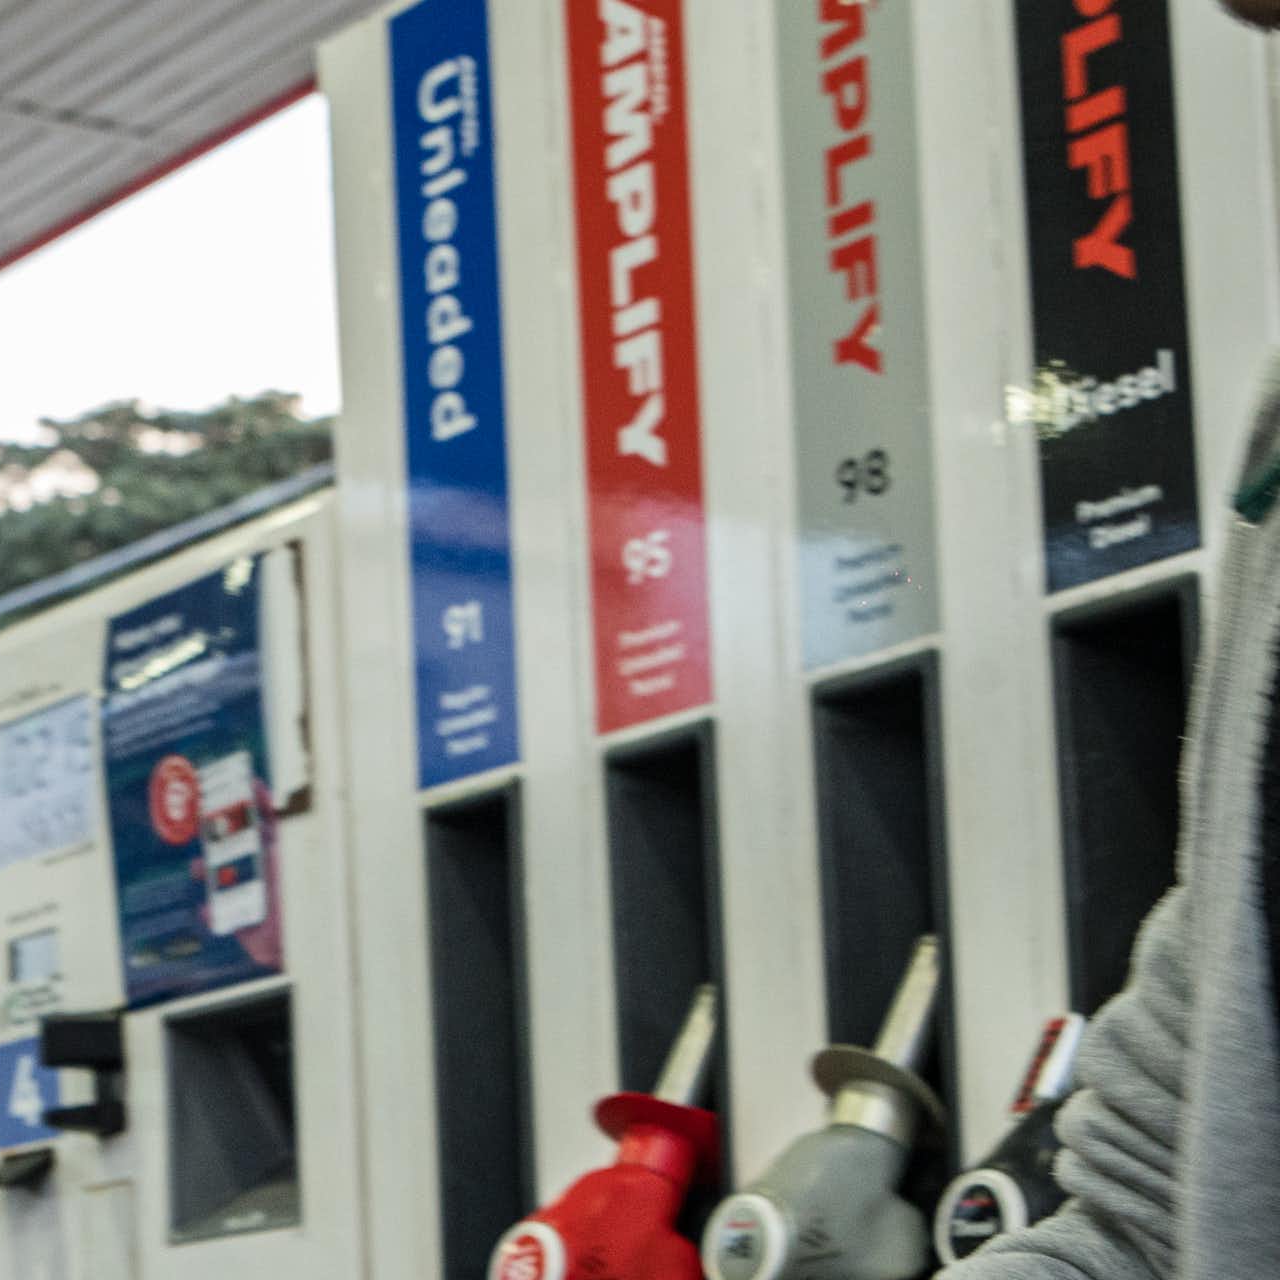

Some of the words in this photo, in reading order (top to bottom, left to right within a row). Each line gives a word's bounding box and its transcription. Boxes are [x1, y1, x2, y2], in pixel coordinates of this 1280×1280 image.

[417, 57, 479, 442] Unleaded
[596, 0, 668, 467] AMPLIFY
[1061, 0, 1137, 280] LIFY
[623, 529, 673, 587] 95
[834, 447, 891, 504] 98
